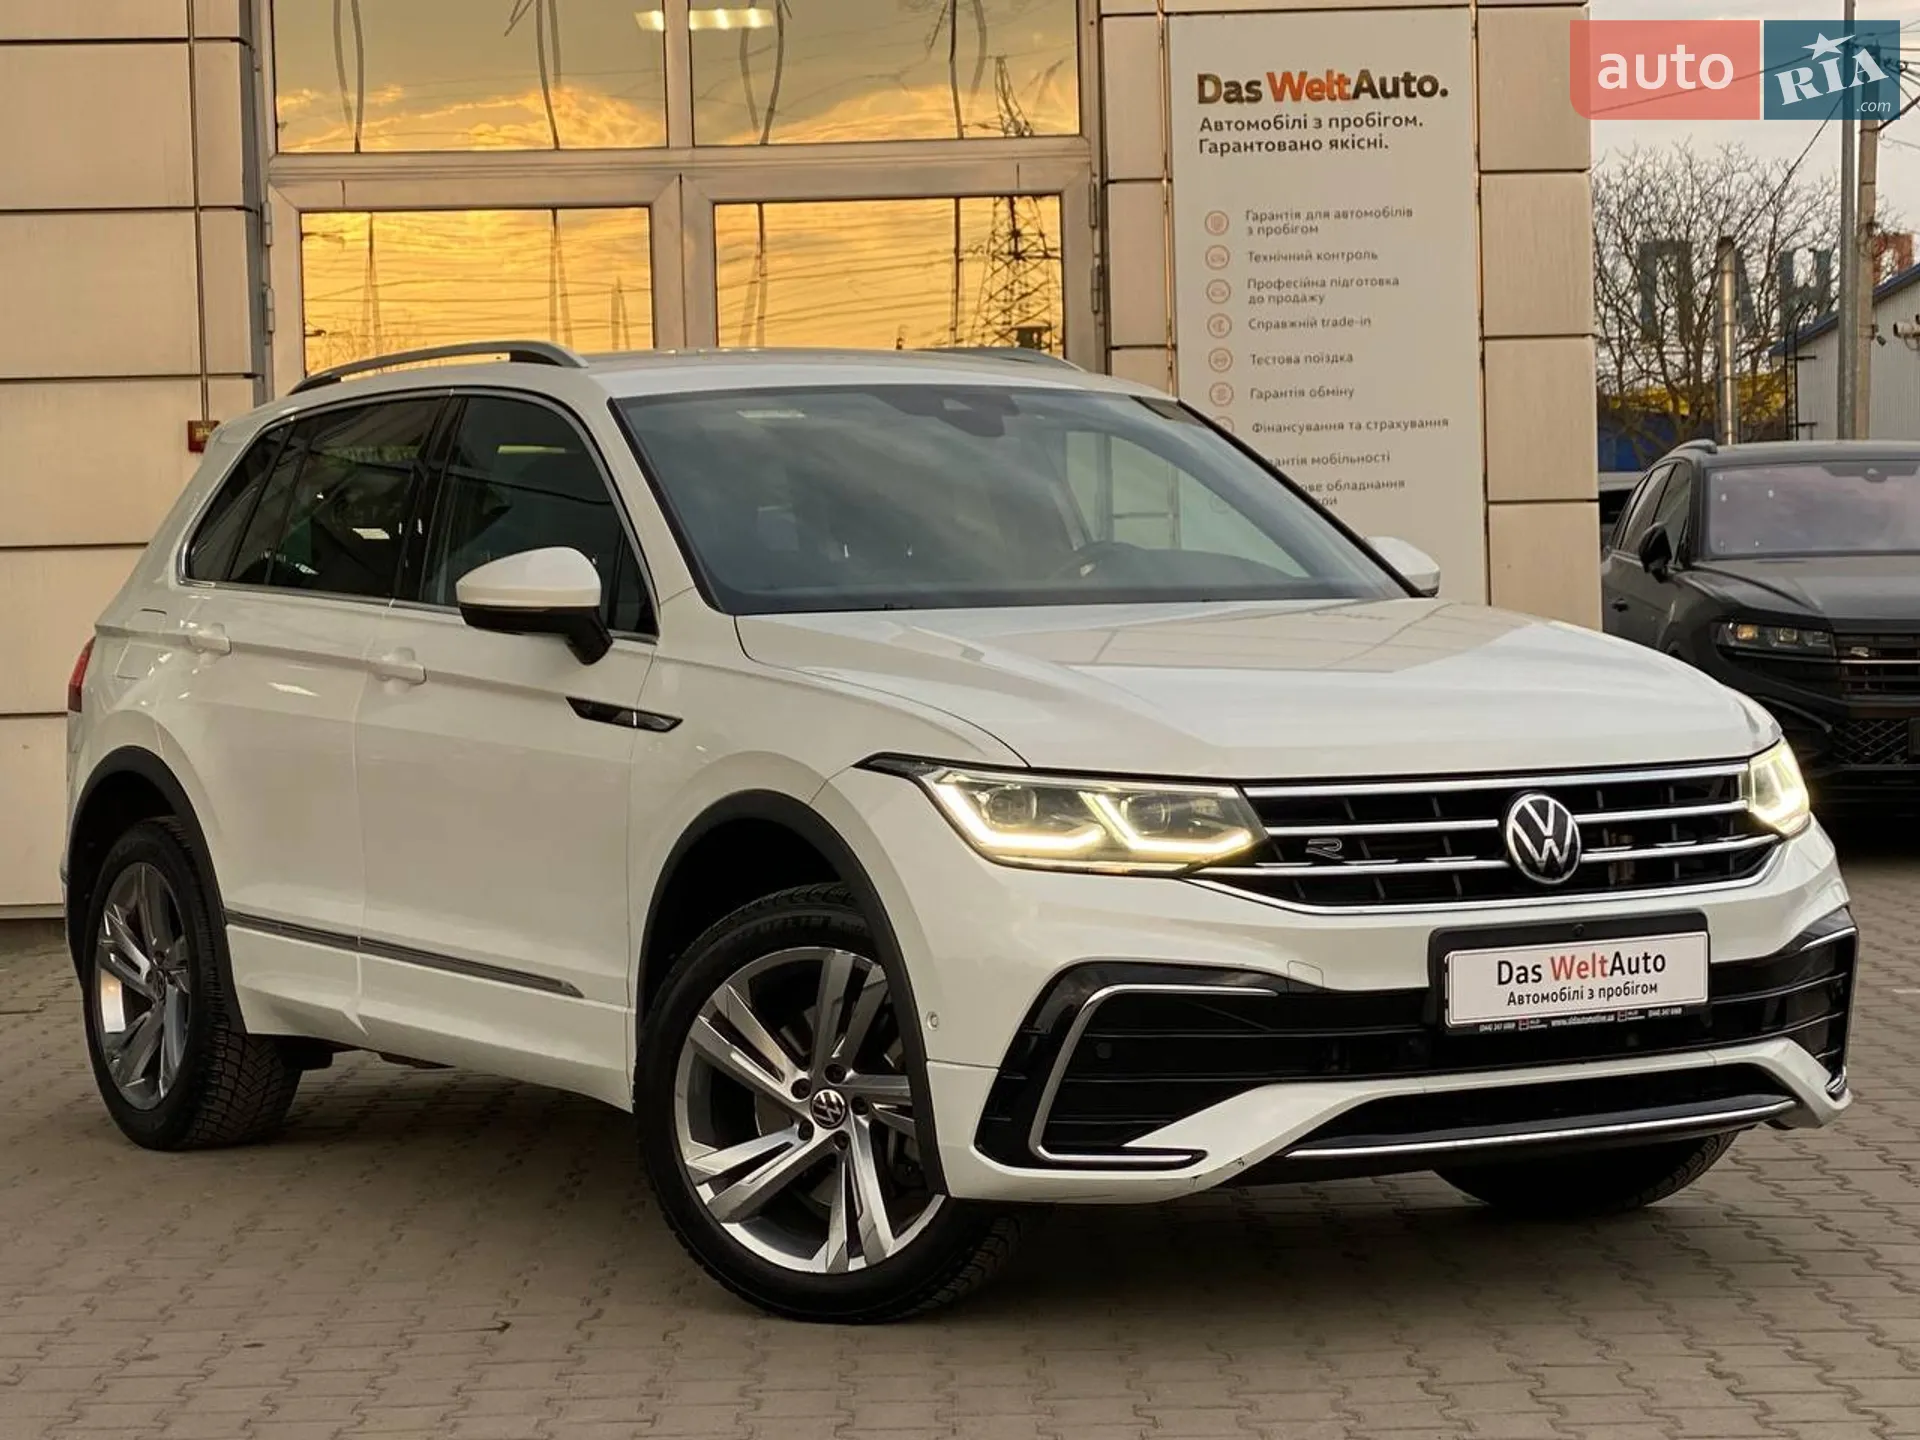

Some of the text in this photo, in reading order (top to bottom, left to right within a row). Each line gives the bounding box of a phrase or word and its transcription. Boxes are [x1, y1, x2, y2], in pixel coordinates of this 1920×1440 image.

[1197, 69, 1449, 104] Das WeltAuto.
[1200, 112, 1424, 132] Автомобілі з пробігом.
[1200, 132, 1390, 157] Гарантовано якісні.
[1246, 206, 1414, 223] Гарантія для автомобілів
[1257, 223, 1319, 237] пробігом
[1249, 250, 1379, 263] Технічний контроль
[1247, 276, 1400, 291] Професійна підготовка
[1248, 293, 1326, 306] до продажу
[1248, 316, 1372, 332] Справжній trade-in
[1250, 352, 1354, 366] Тестова поїздка
[1251, 386, 1355, 402] Гарантія обміну
[1252, 417, 1449, 435] Фінансування та страхування
[1311, 451, 1391, 465] мобільності
[1326, 480, 1405, 492] обладнання
[1497, 951, 1666, 986] Das WeltAuto
[1507, 980, 1658, 1007] Автомобілі з пробігом
